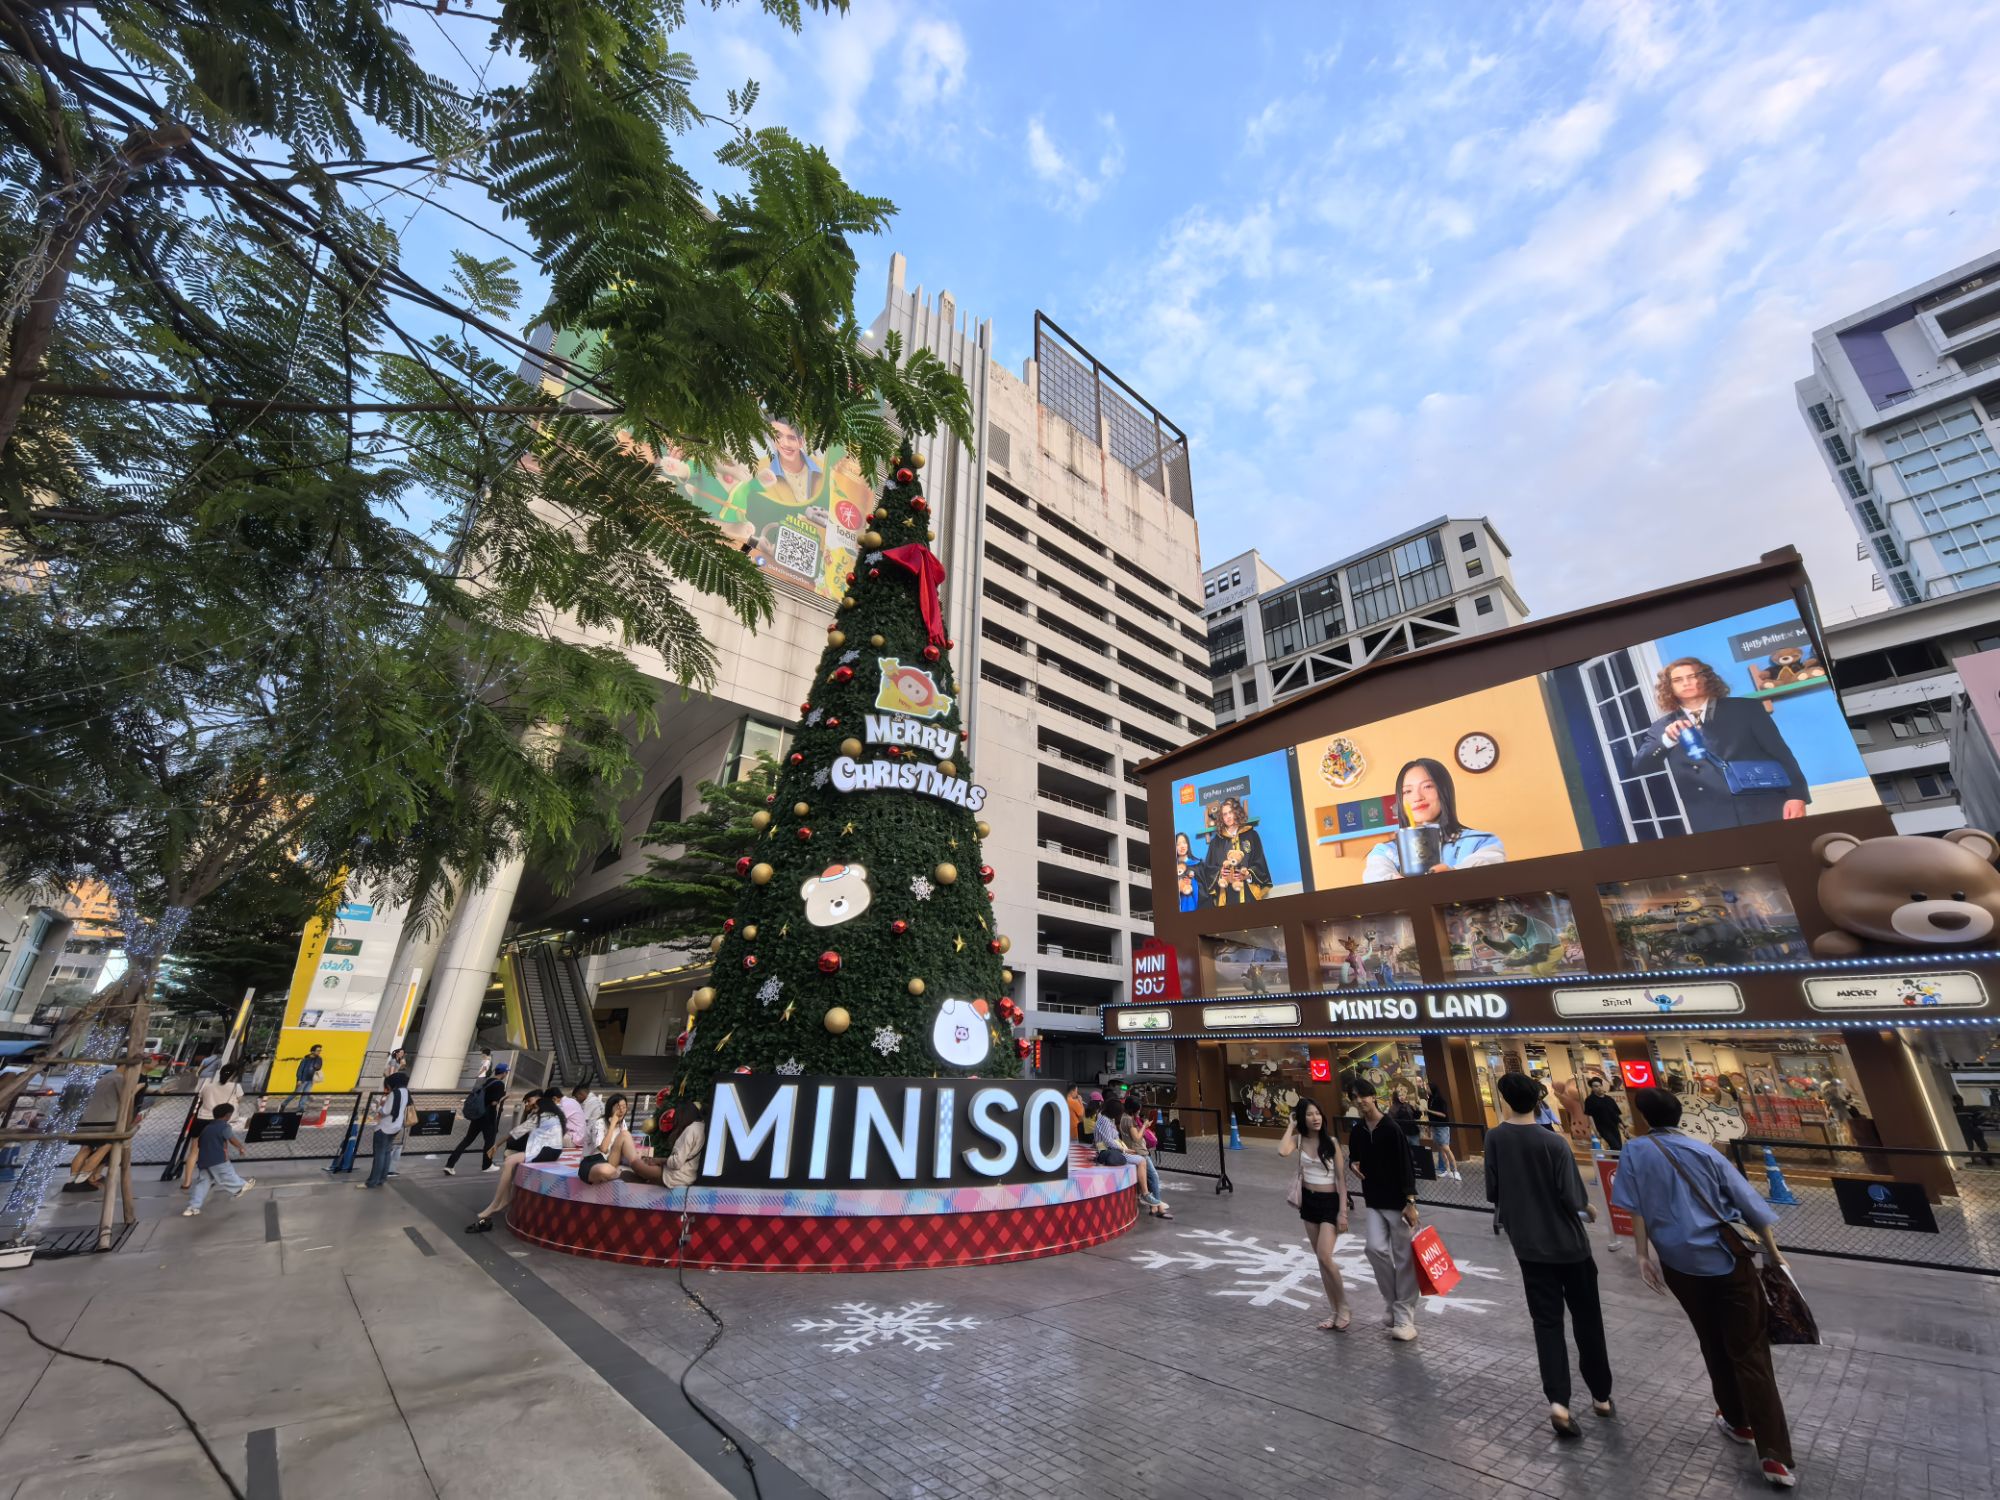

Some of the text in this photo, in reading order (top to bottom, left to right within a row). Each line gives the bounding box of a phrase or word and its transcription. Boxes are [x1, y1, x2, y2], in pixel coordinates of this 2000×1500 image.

[865, 714, 957, 760] MERRY
[831, 756, 987, 811] CHRISTMAS
[1135, 953, 1166, 975] MINI
[1328, 993, 1508, 1022] MINISO LAND
[1836, 989, 1878, 998] MICKEY
[702, 1083, 1070, 1180] MINISO
[1421, 1242, 1442, 1265] MINI
